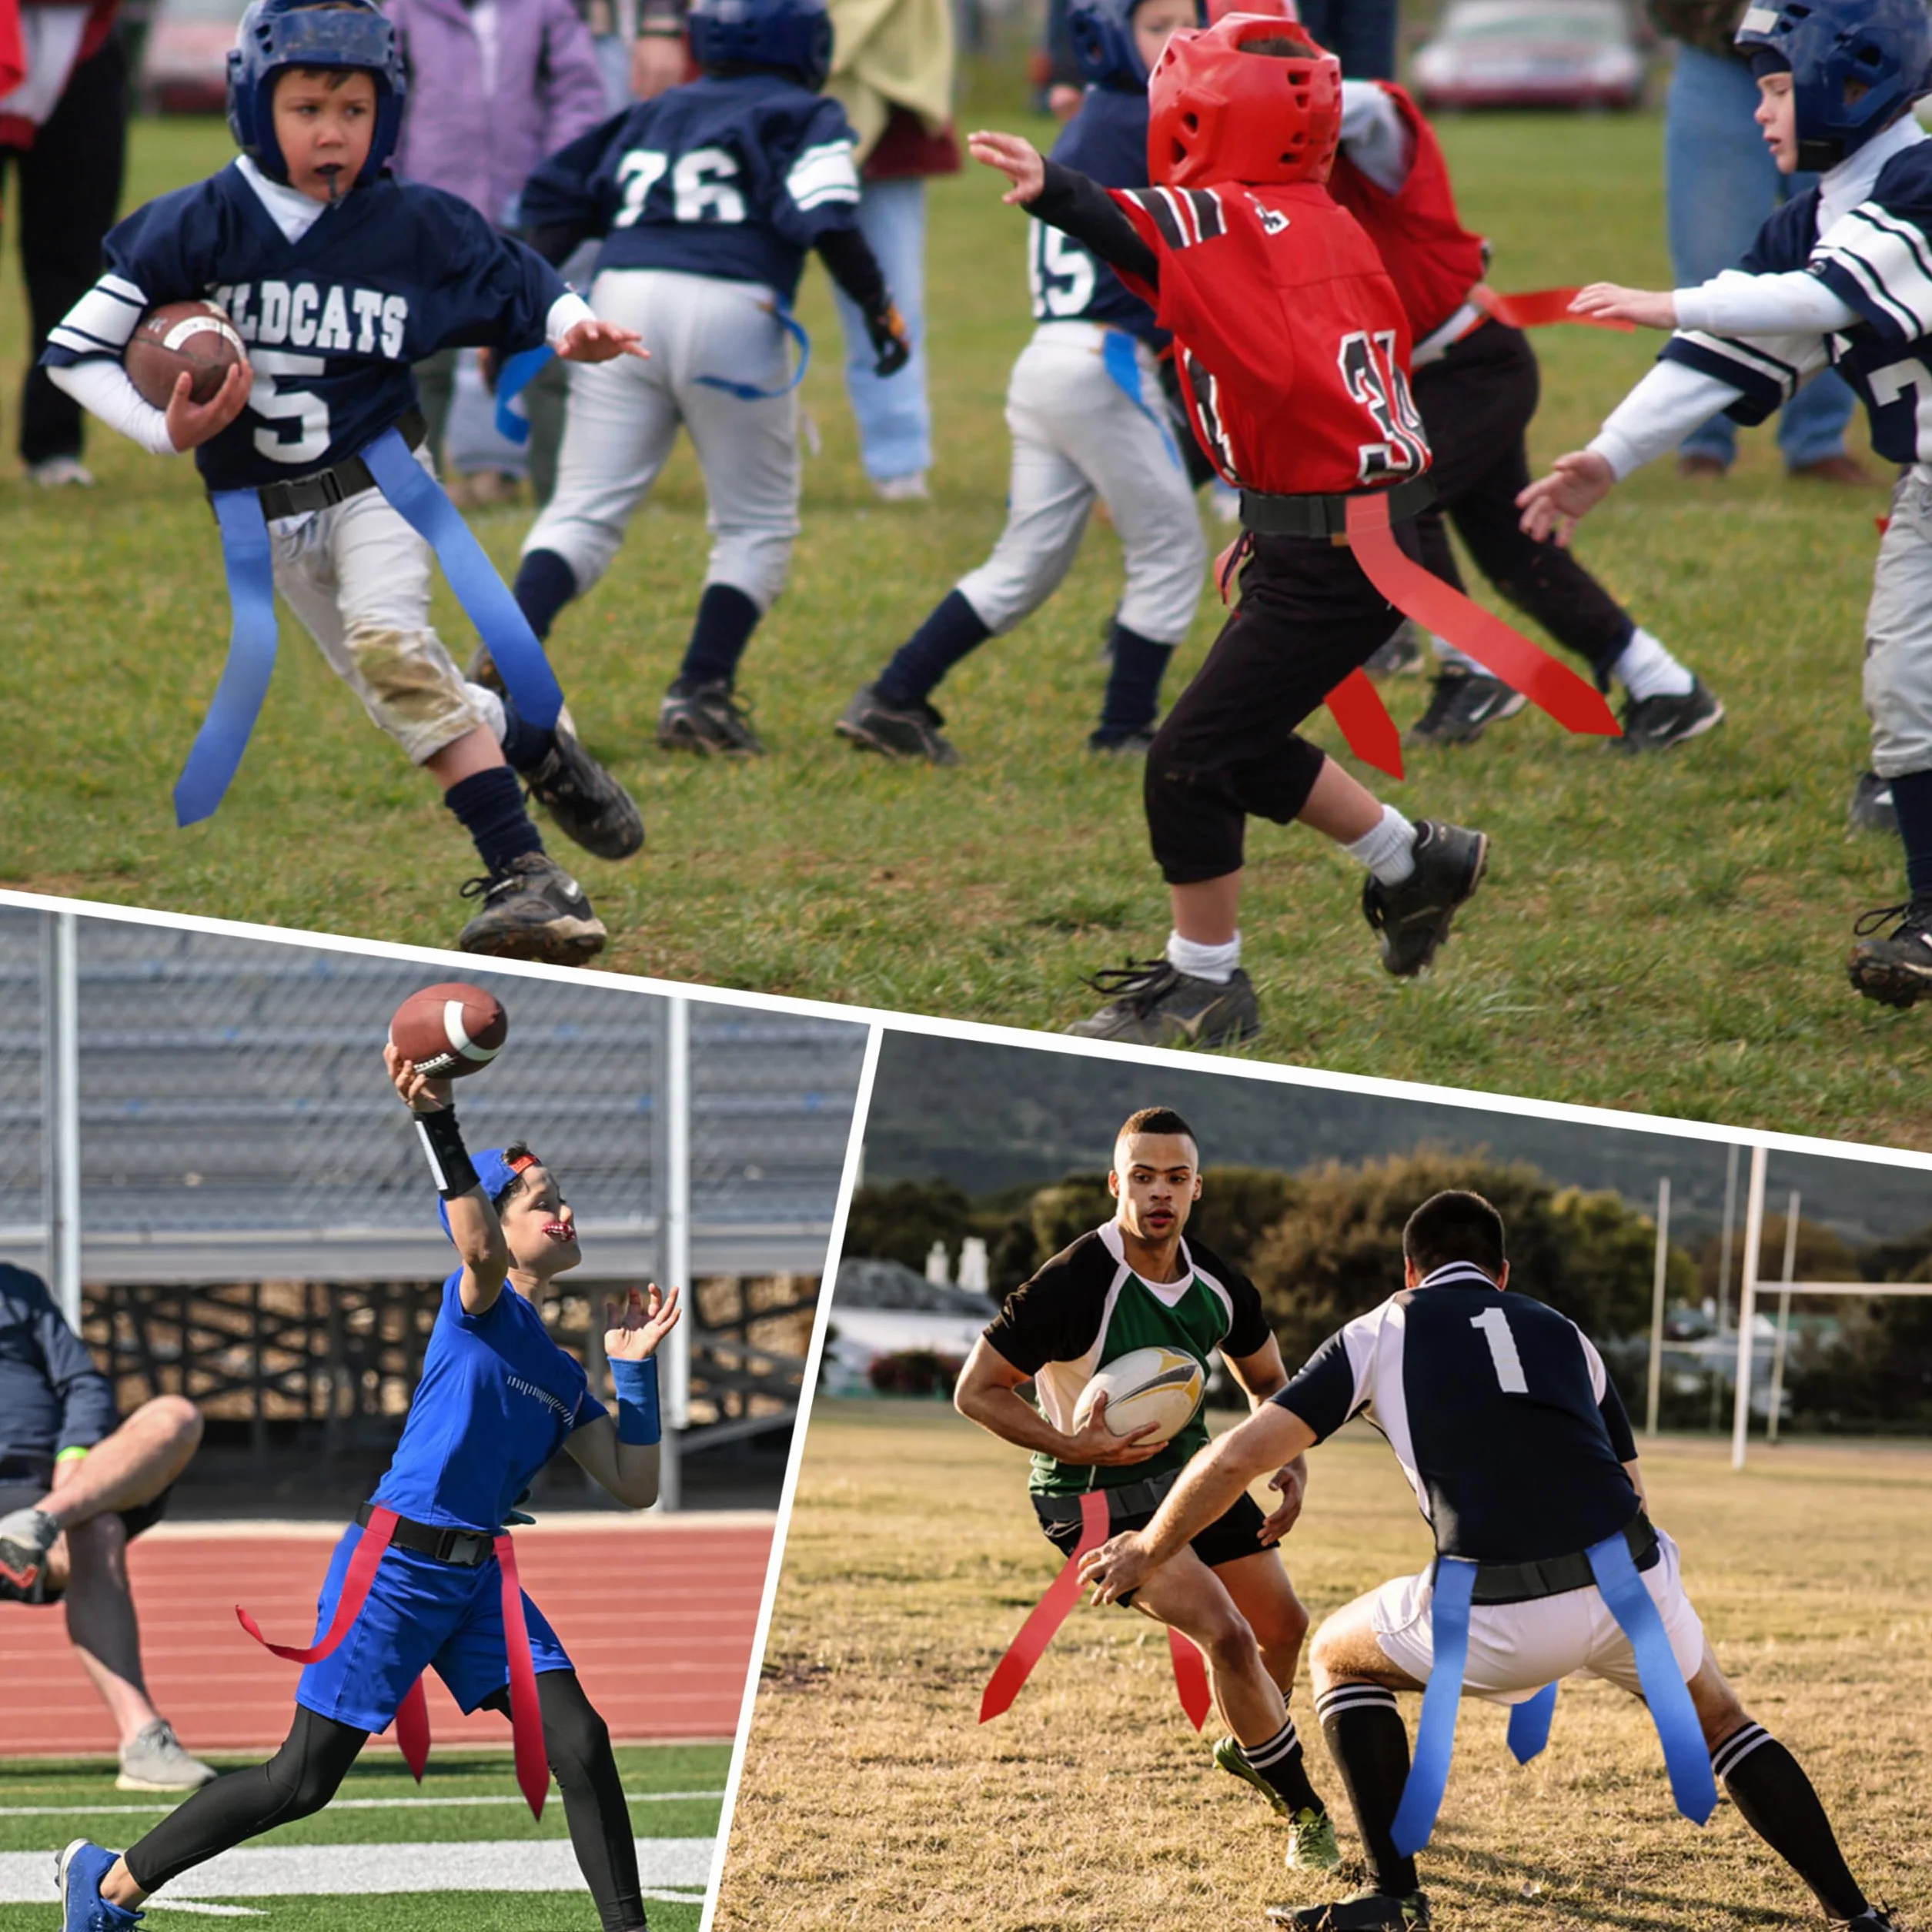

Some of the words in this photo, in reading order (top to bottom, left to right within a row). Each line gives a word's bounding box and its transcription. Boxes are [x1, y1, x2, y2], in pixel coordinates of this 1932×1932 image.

[615, 146, 746, 228] 76
[203, 281, 408, 359] ILDCATS
[248, 348, 331, 463] 5
[1469, 1307, 1529, 1393] 1
